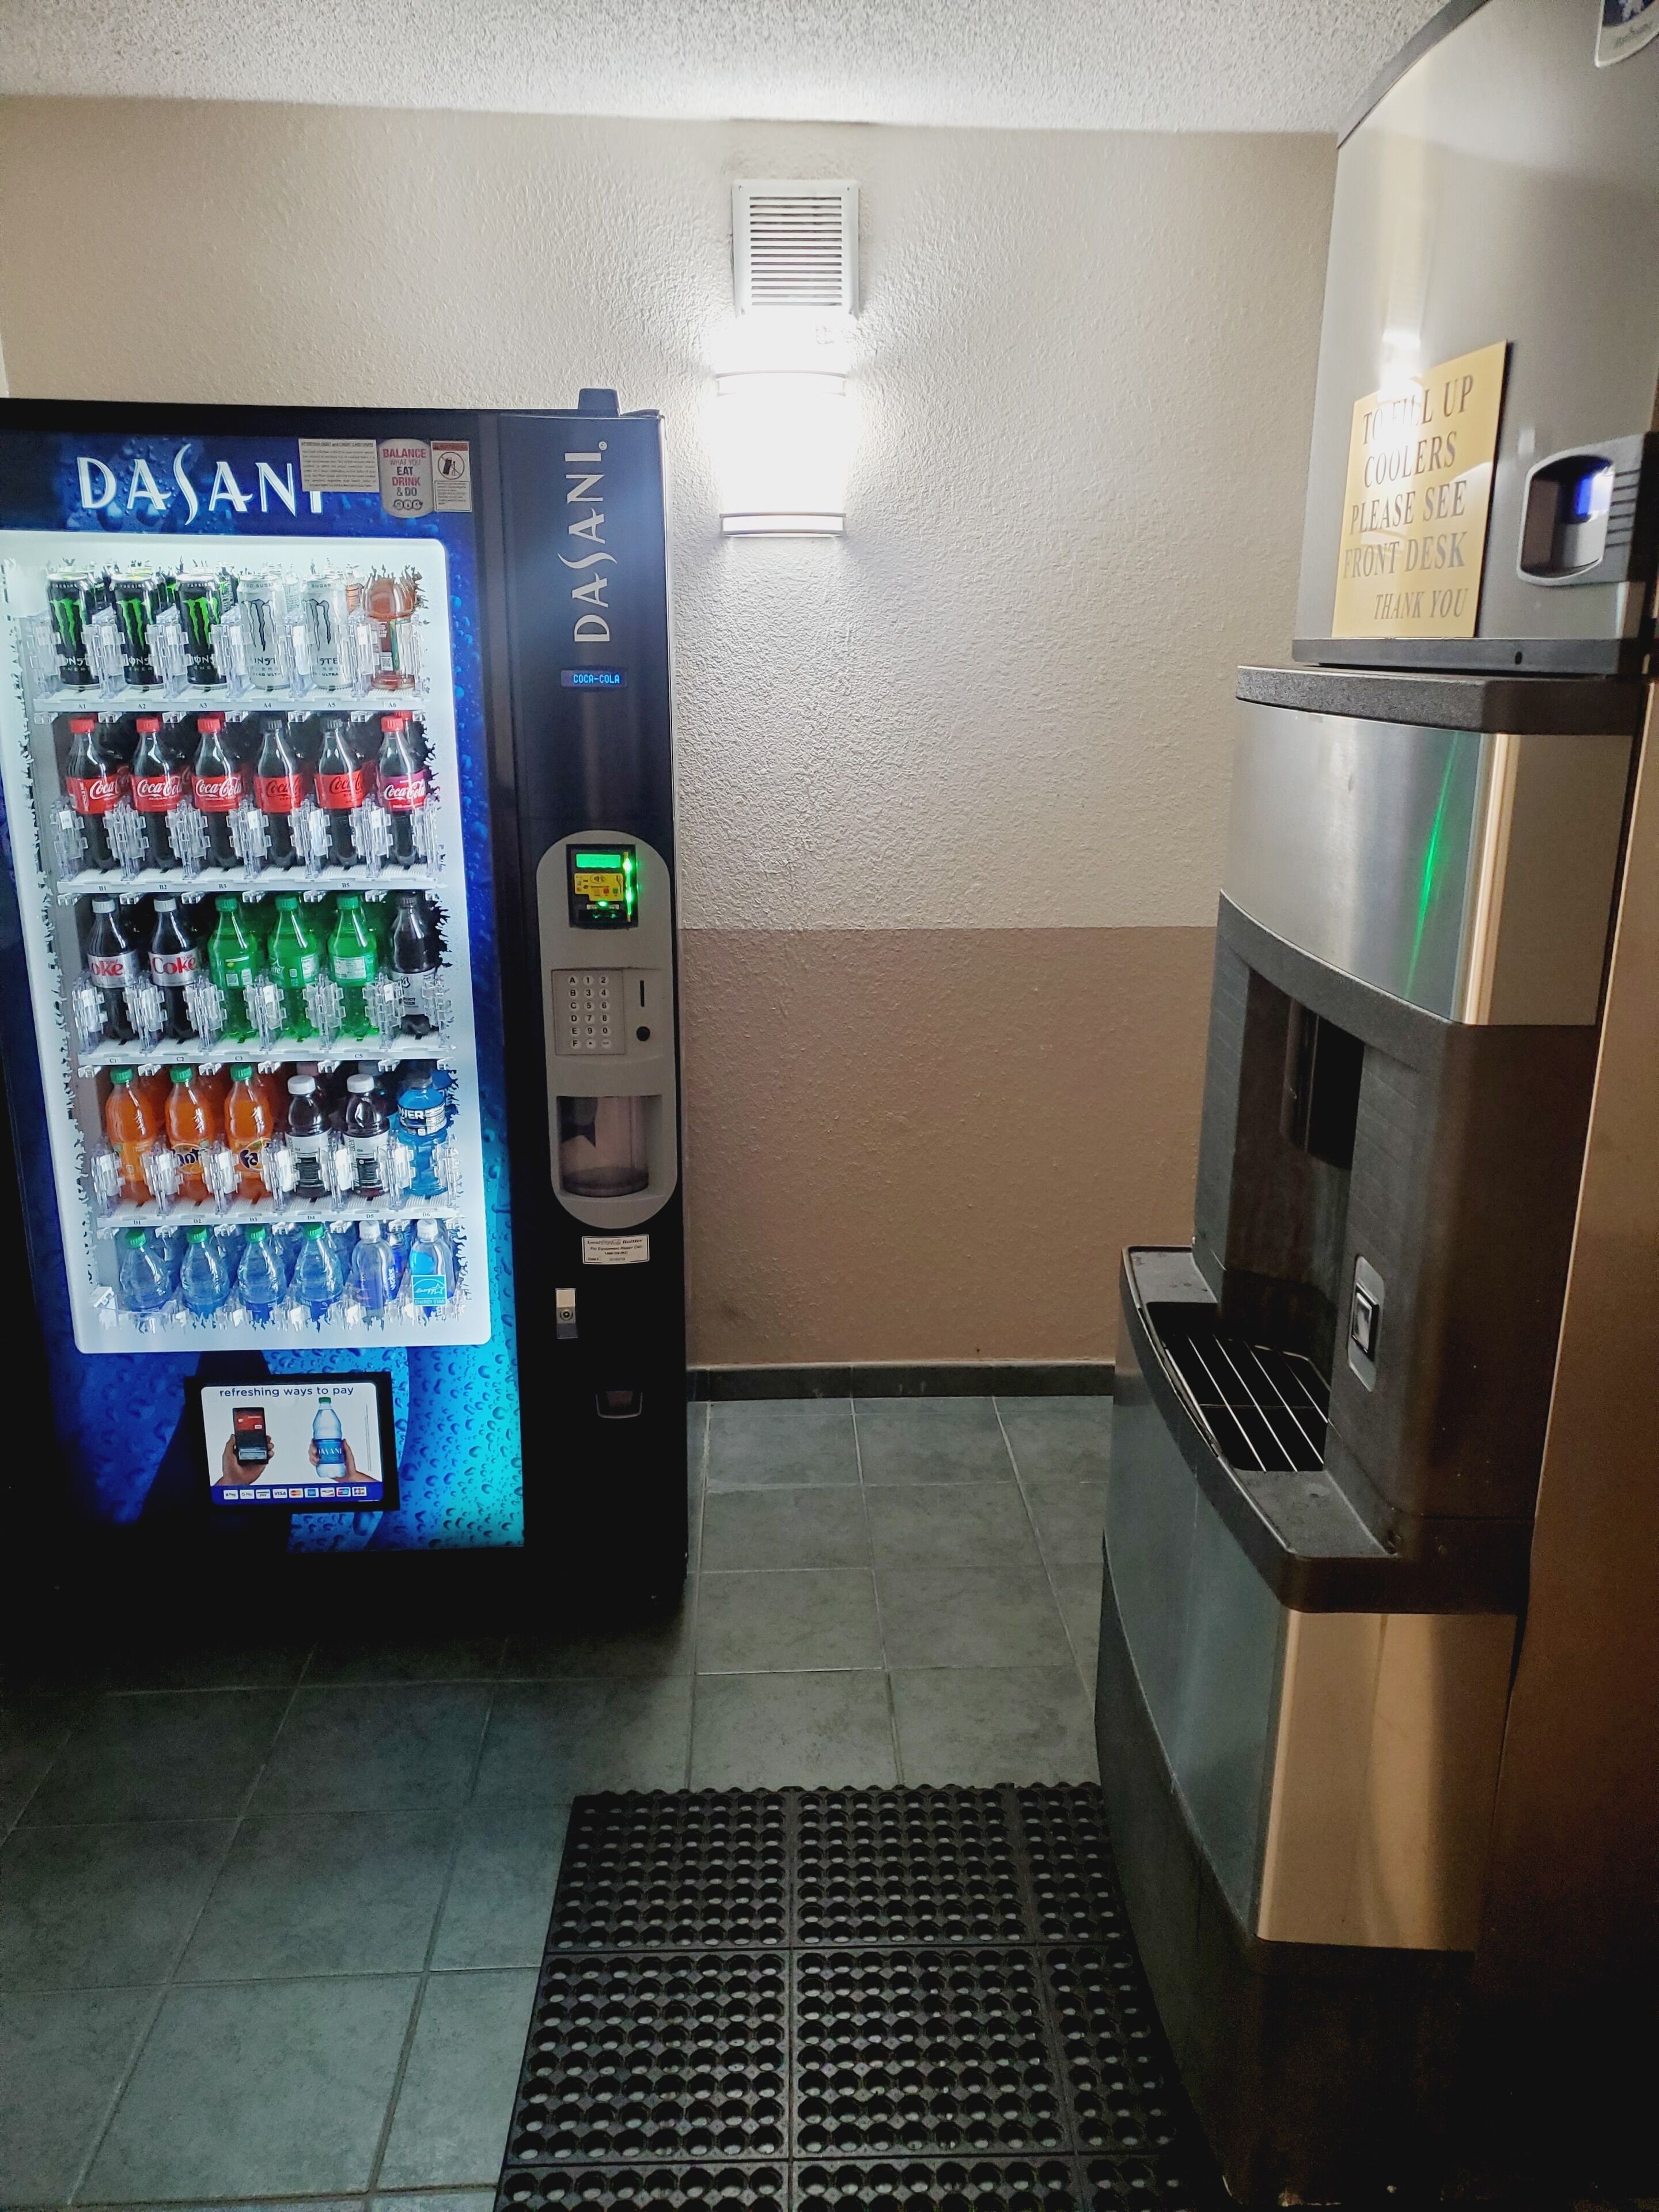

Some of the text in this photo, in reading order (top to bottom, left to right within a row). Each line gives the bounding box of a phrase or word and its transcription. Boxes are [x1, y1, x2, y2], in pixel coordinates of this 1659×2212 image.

[1443, 374, 1474, 417] UP
[382, 448, 427, 459] BALANCE
[1363, 430, 1457, 488] COOLERS
[396, 466, 414, 476] EAT
[392, 477, 421, 486] DRINK
[396, 487, 418, 497] & DO
[1349, 480, 1467, 535] PLEASE SEE
[1343, 531, 1468, 579] FRONT DESK
[1374, 588, 1469, 620] THANK YOU
[573, 674, 620, 684] COCA-COLA
[151, 957, 196, 975] Coke
[219, 1387, 354, 1397] refreshing ways to pay
